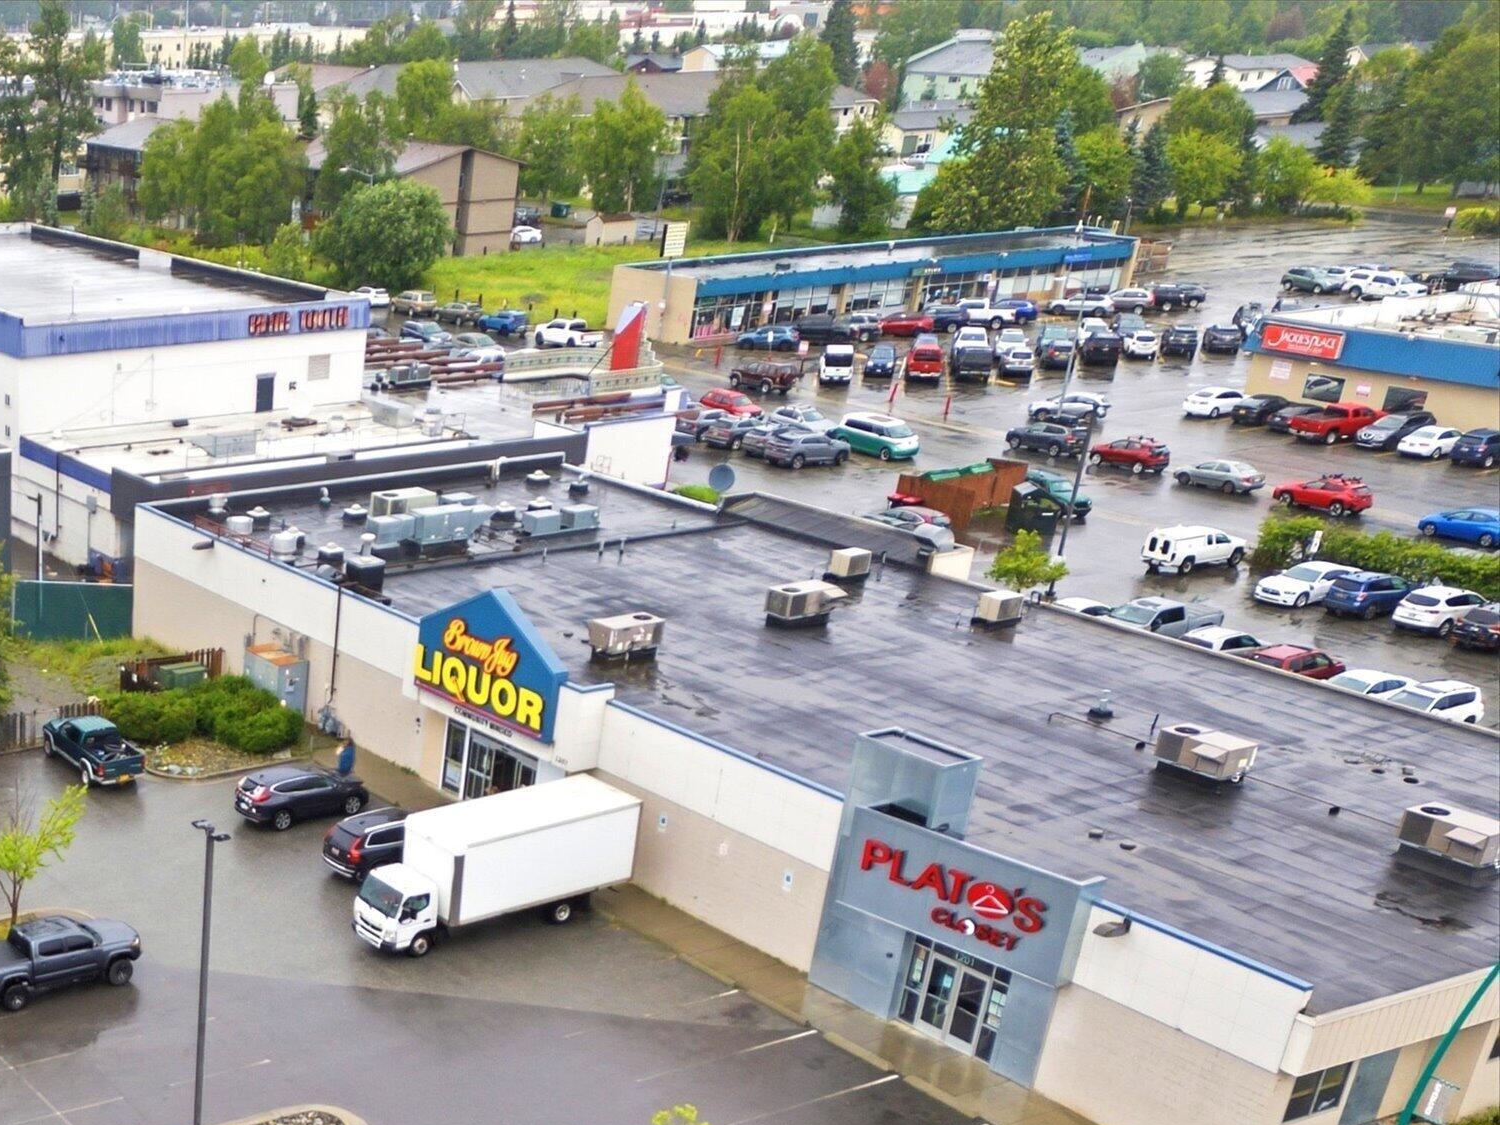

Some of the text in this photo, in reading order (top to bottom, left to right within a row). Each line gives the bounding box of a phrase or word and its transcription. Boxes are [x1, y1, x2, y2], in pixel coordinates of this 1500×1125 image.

[443, 617, 519, 677] Brown Jug
[414, 643, 543, 730] LIQUOR
[860, 838, 1048, 933] PLATO'S
[930, 907, 1020, 951] CLOSET
